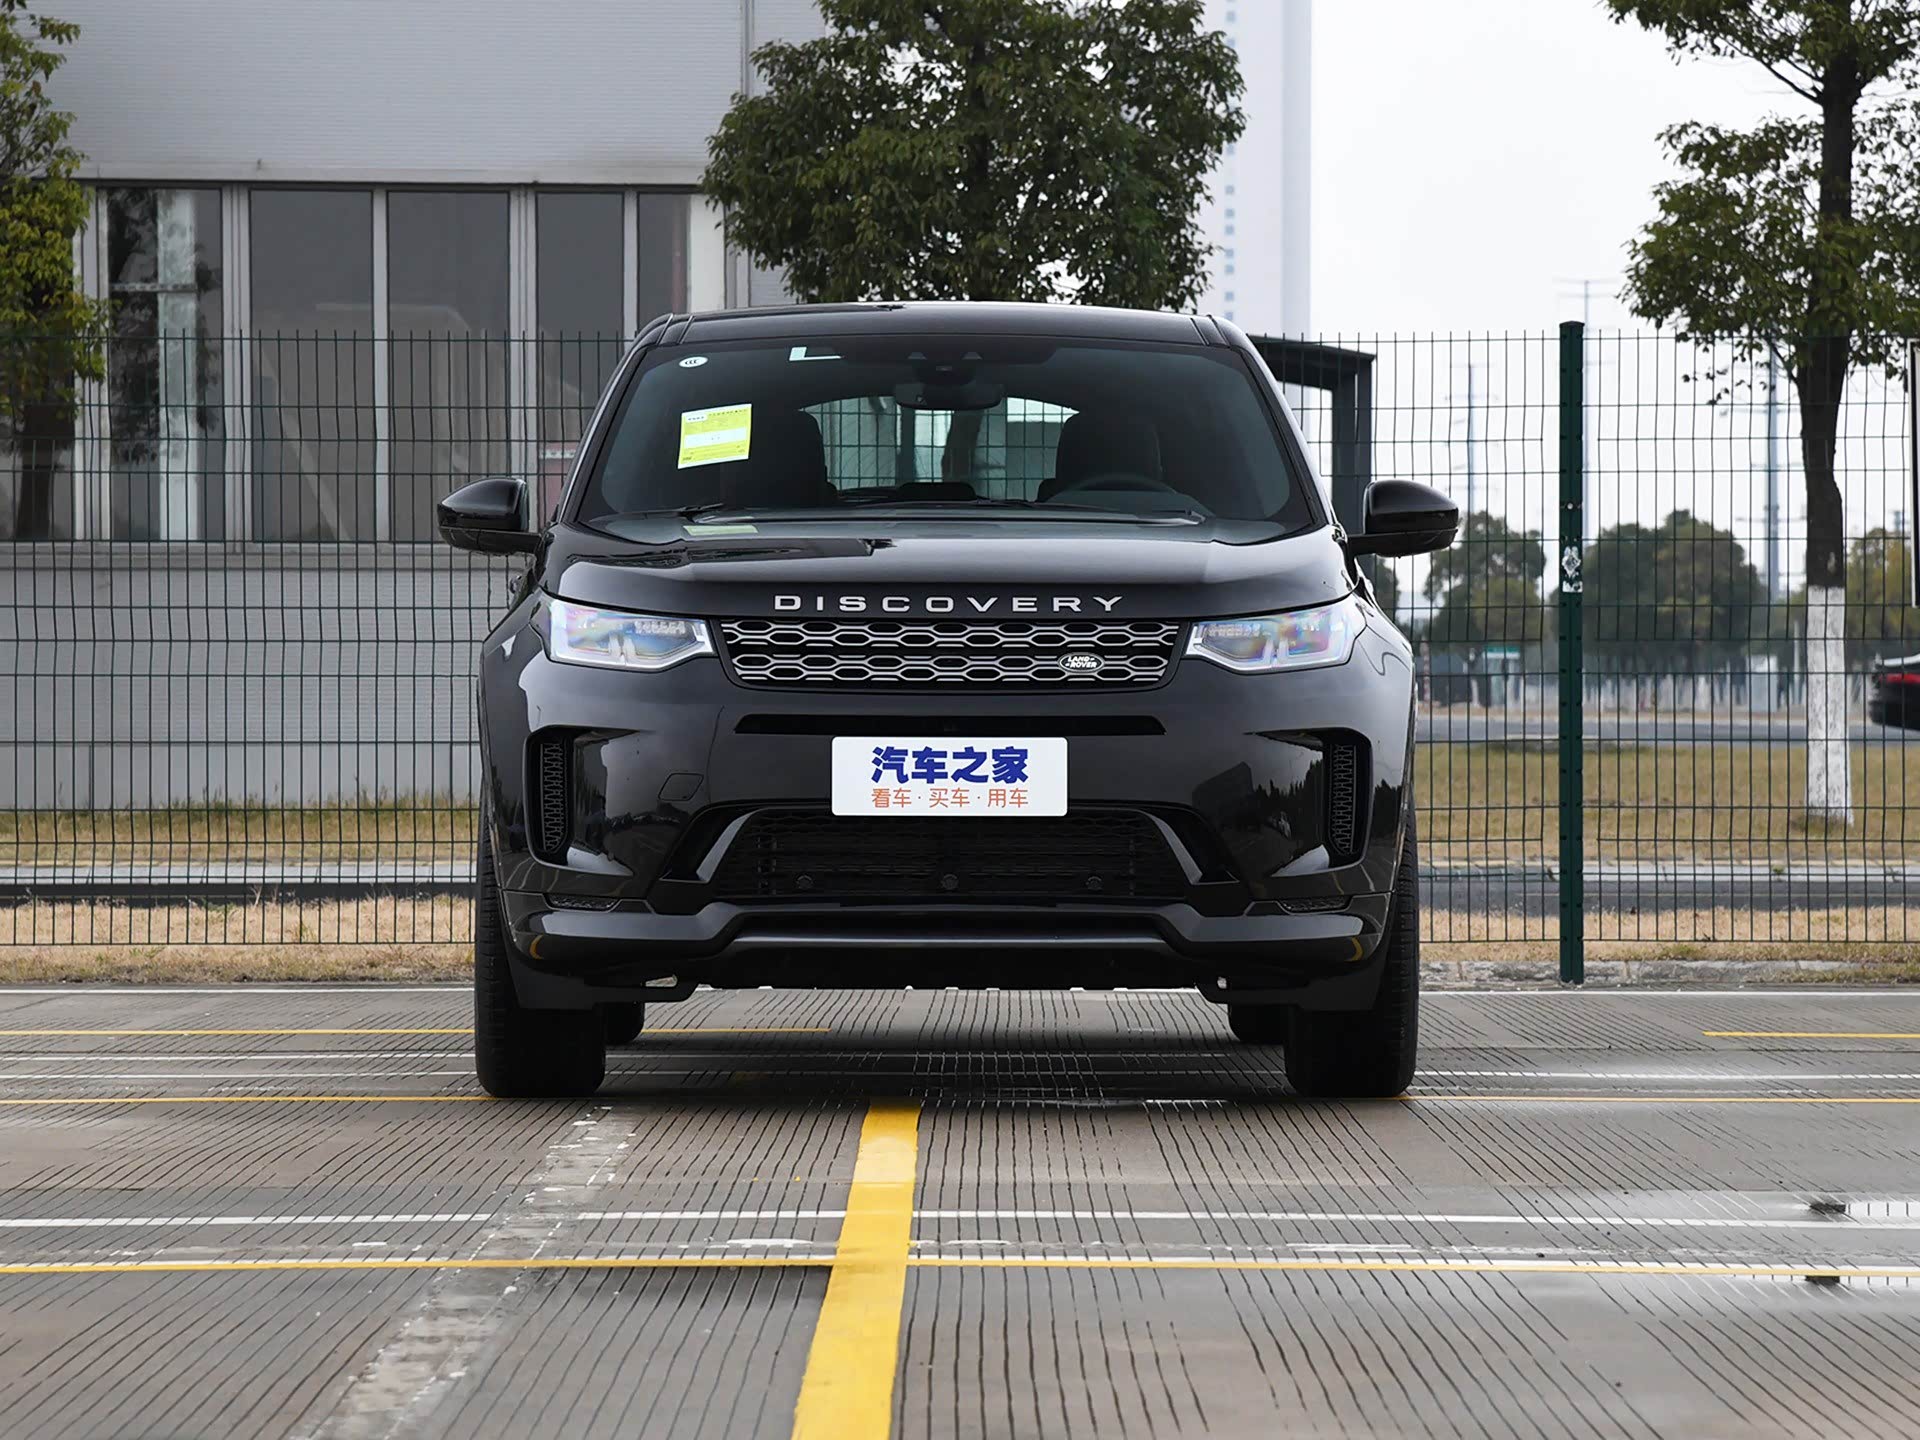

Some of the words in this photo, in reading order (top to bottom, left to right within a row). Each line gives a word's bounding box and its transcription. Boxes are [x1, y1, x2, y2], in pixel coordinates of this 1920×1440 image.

[774, 595, 1122, 612] DISCOVERY
[871, 746, 1029, 784] 汽车之家
